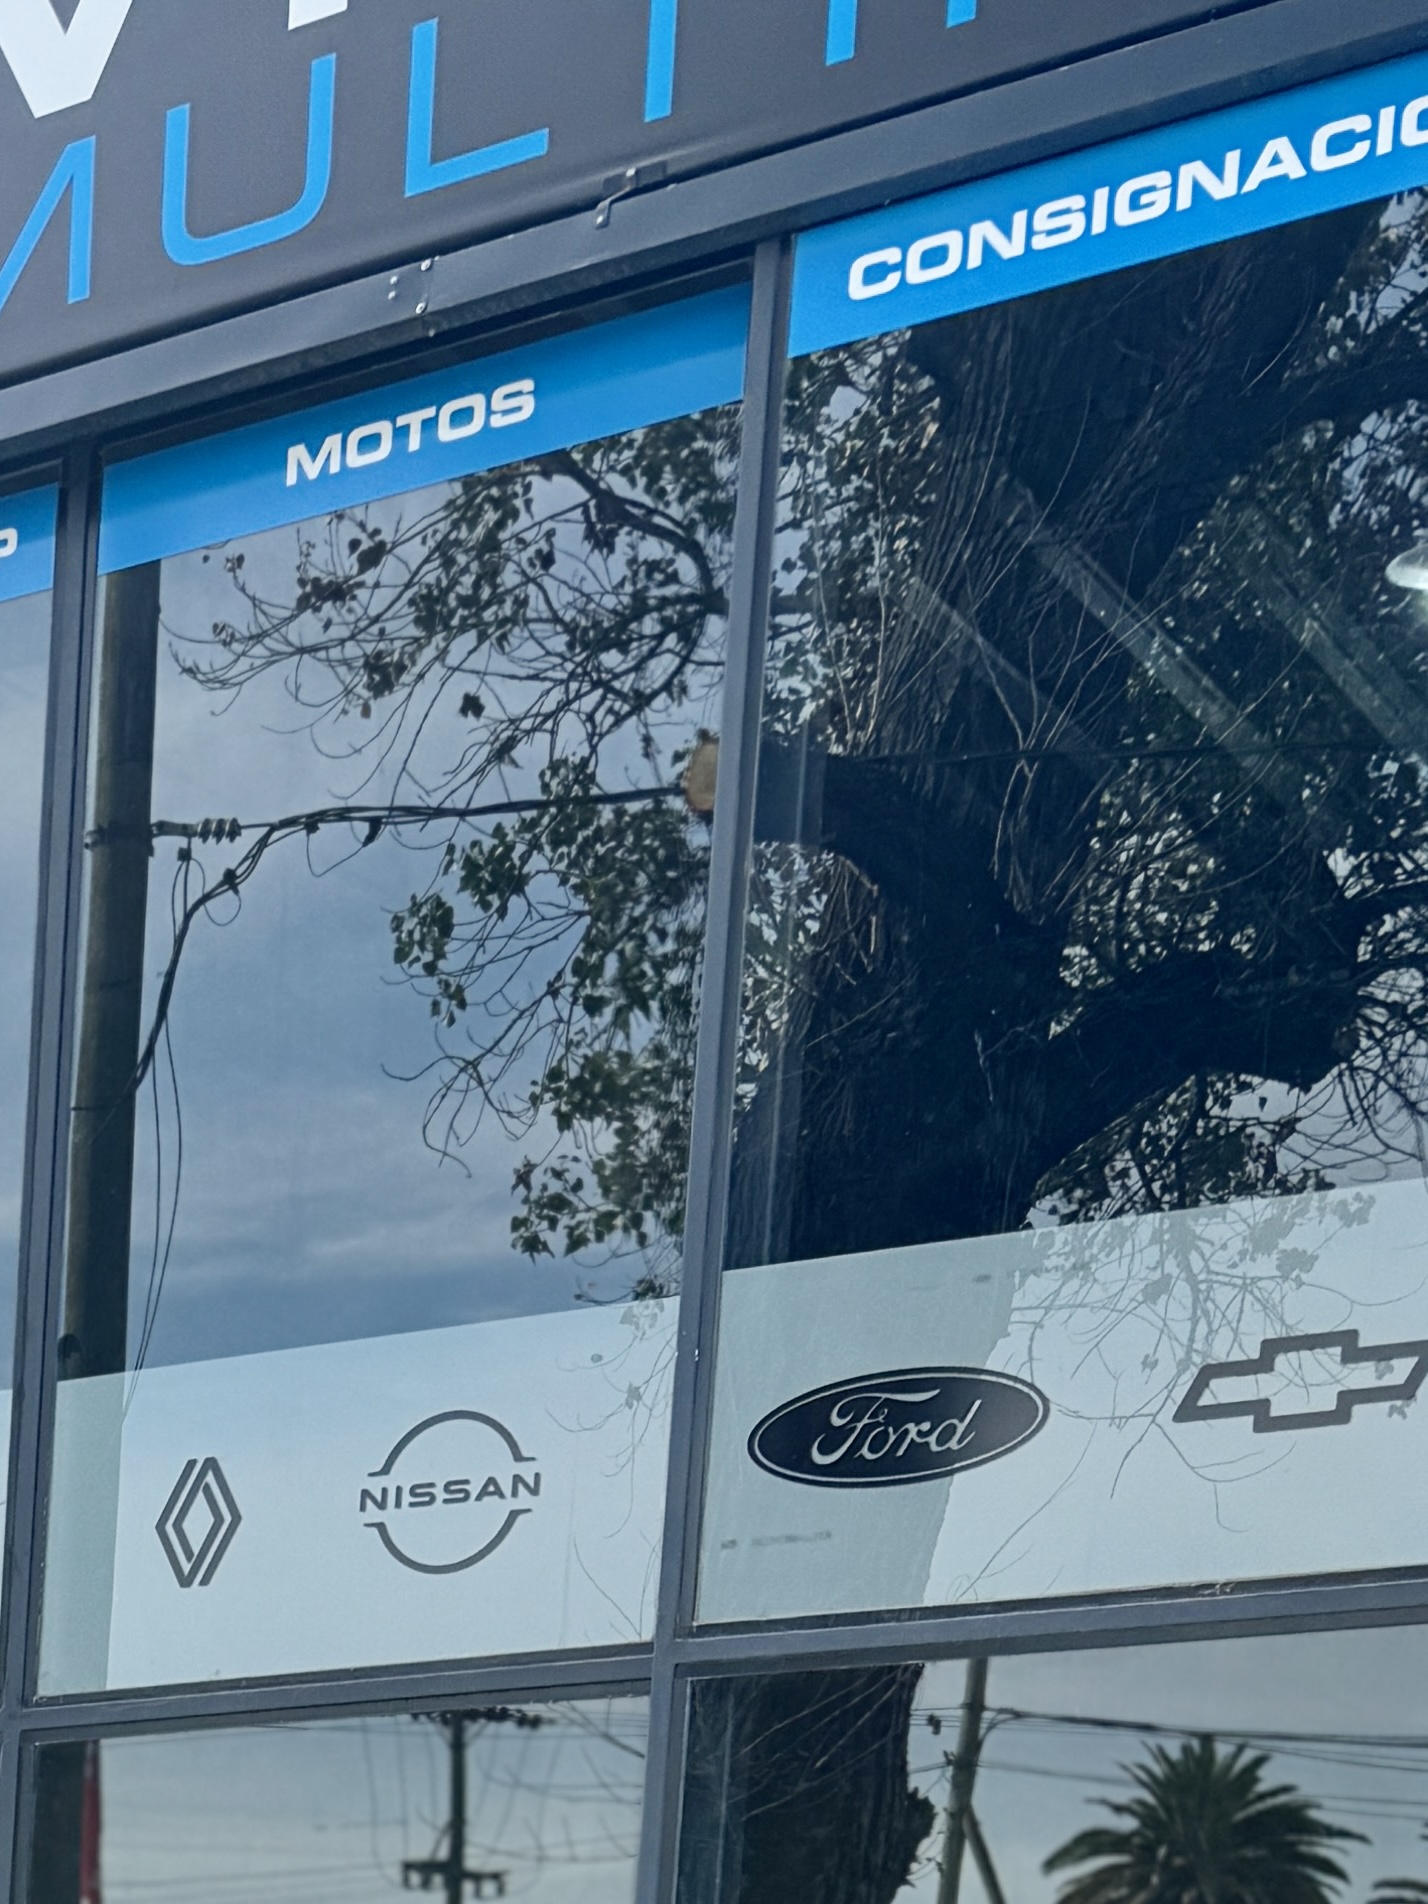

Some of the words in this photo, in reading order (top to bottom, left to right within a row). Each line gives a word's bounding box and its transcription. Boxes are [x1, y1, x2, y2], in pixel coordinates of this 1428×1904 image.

[283, 378, 537, 487] MOTOS
[809, 1391, 977, 1467] Ford
[358, 1471, 542, 1515] NISSAN
